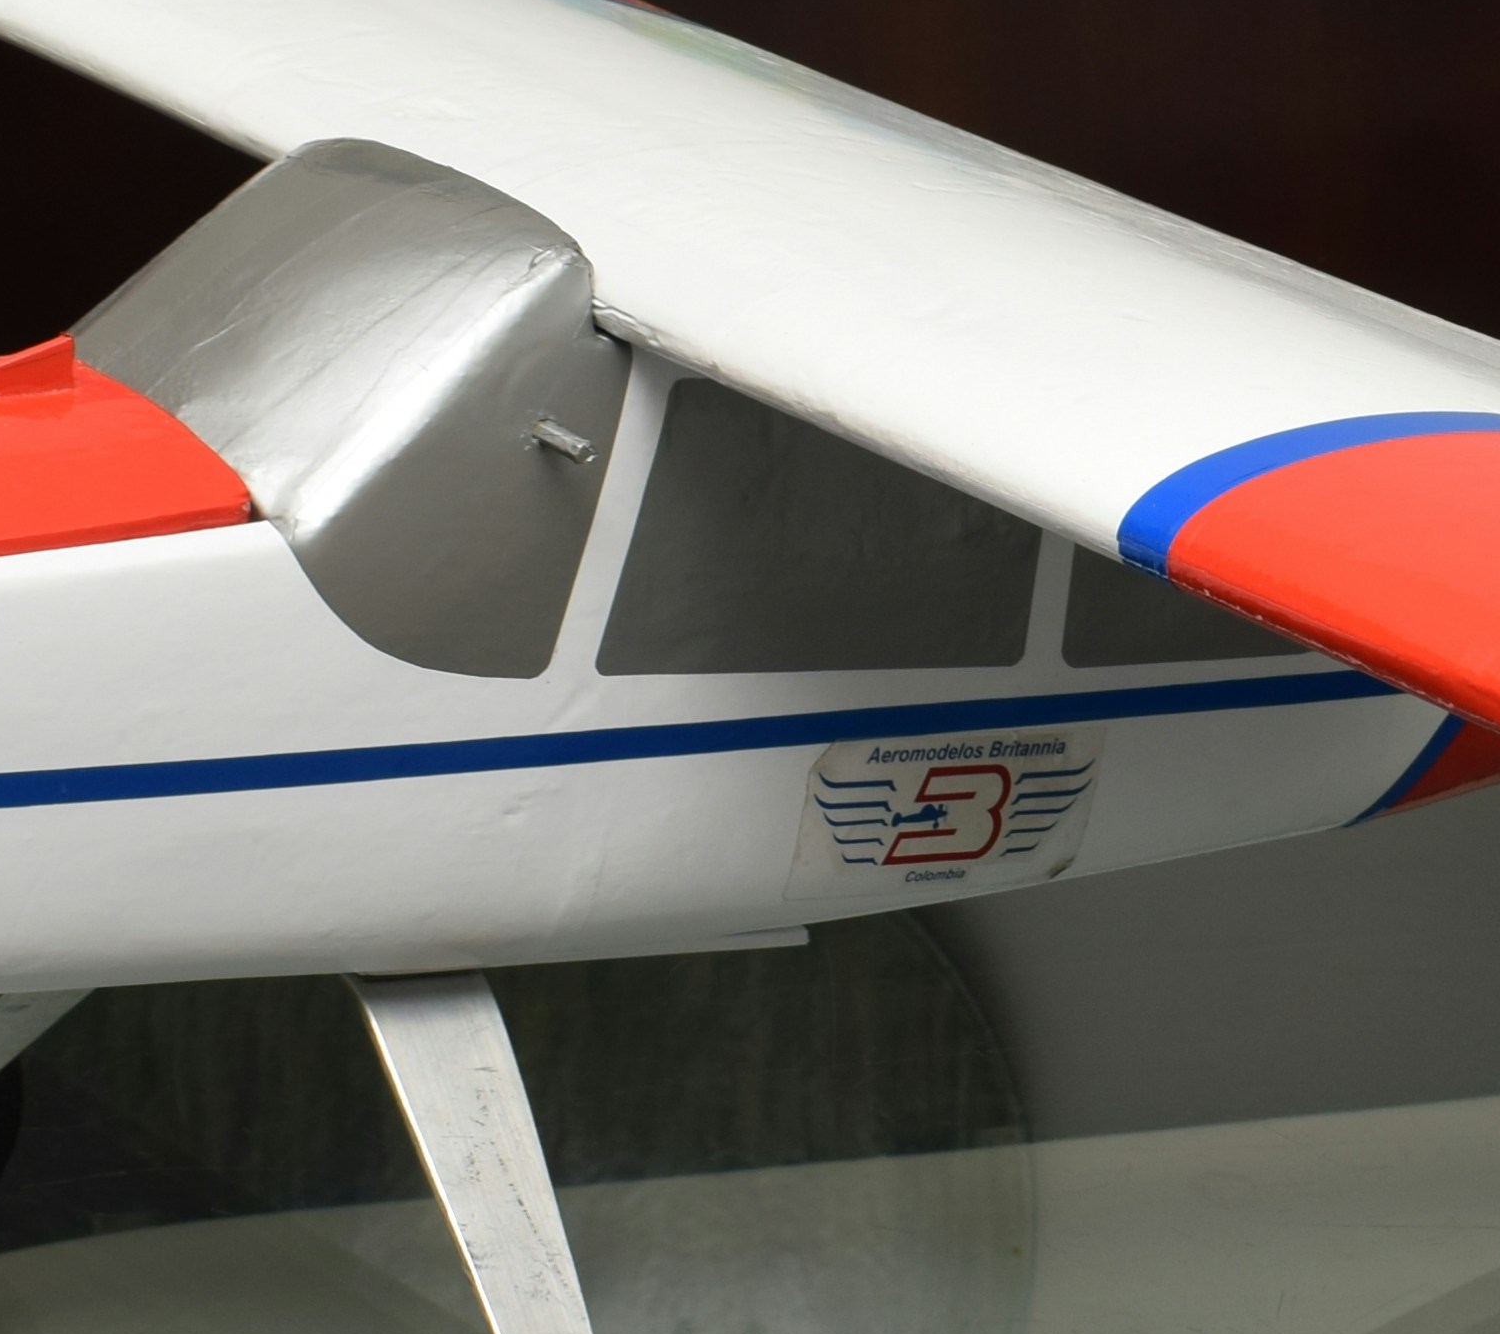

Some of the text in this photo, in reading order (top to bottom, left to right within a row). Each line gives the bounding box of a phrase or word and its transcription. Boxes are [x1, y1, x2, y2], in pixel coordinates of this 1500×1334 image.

[867, 740, 1066, 764] Aeromodelos Britannia
[904, 869, 965, 883] Colombia
